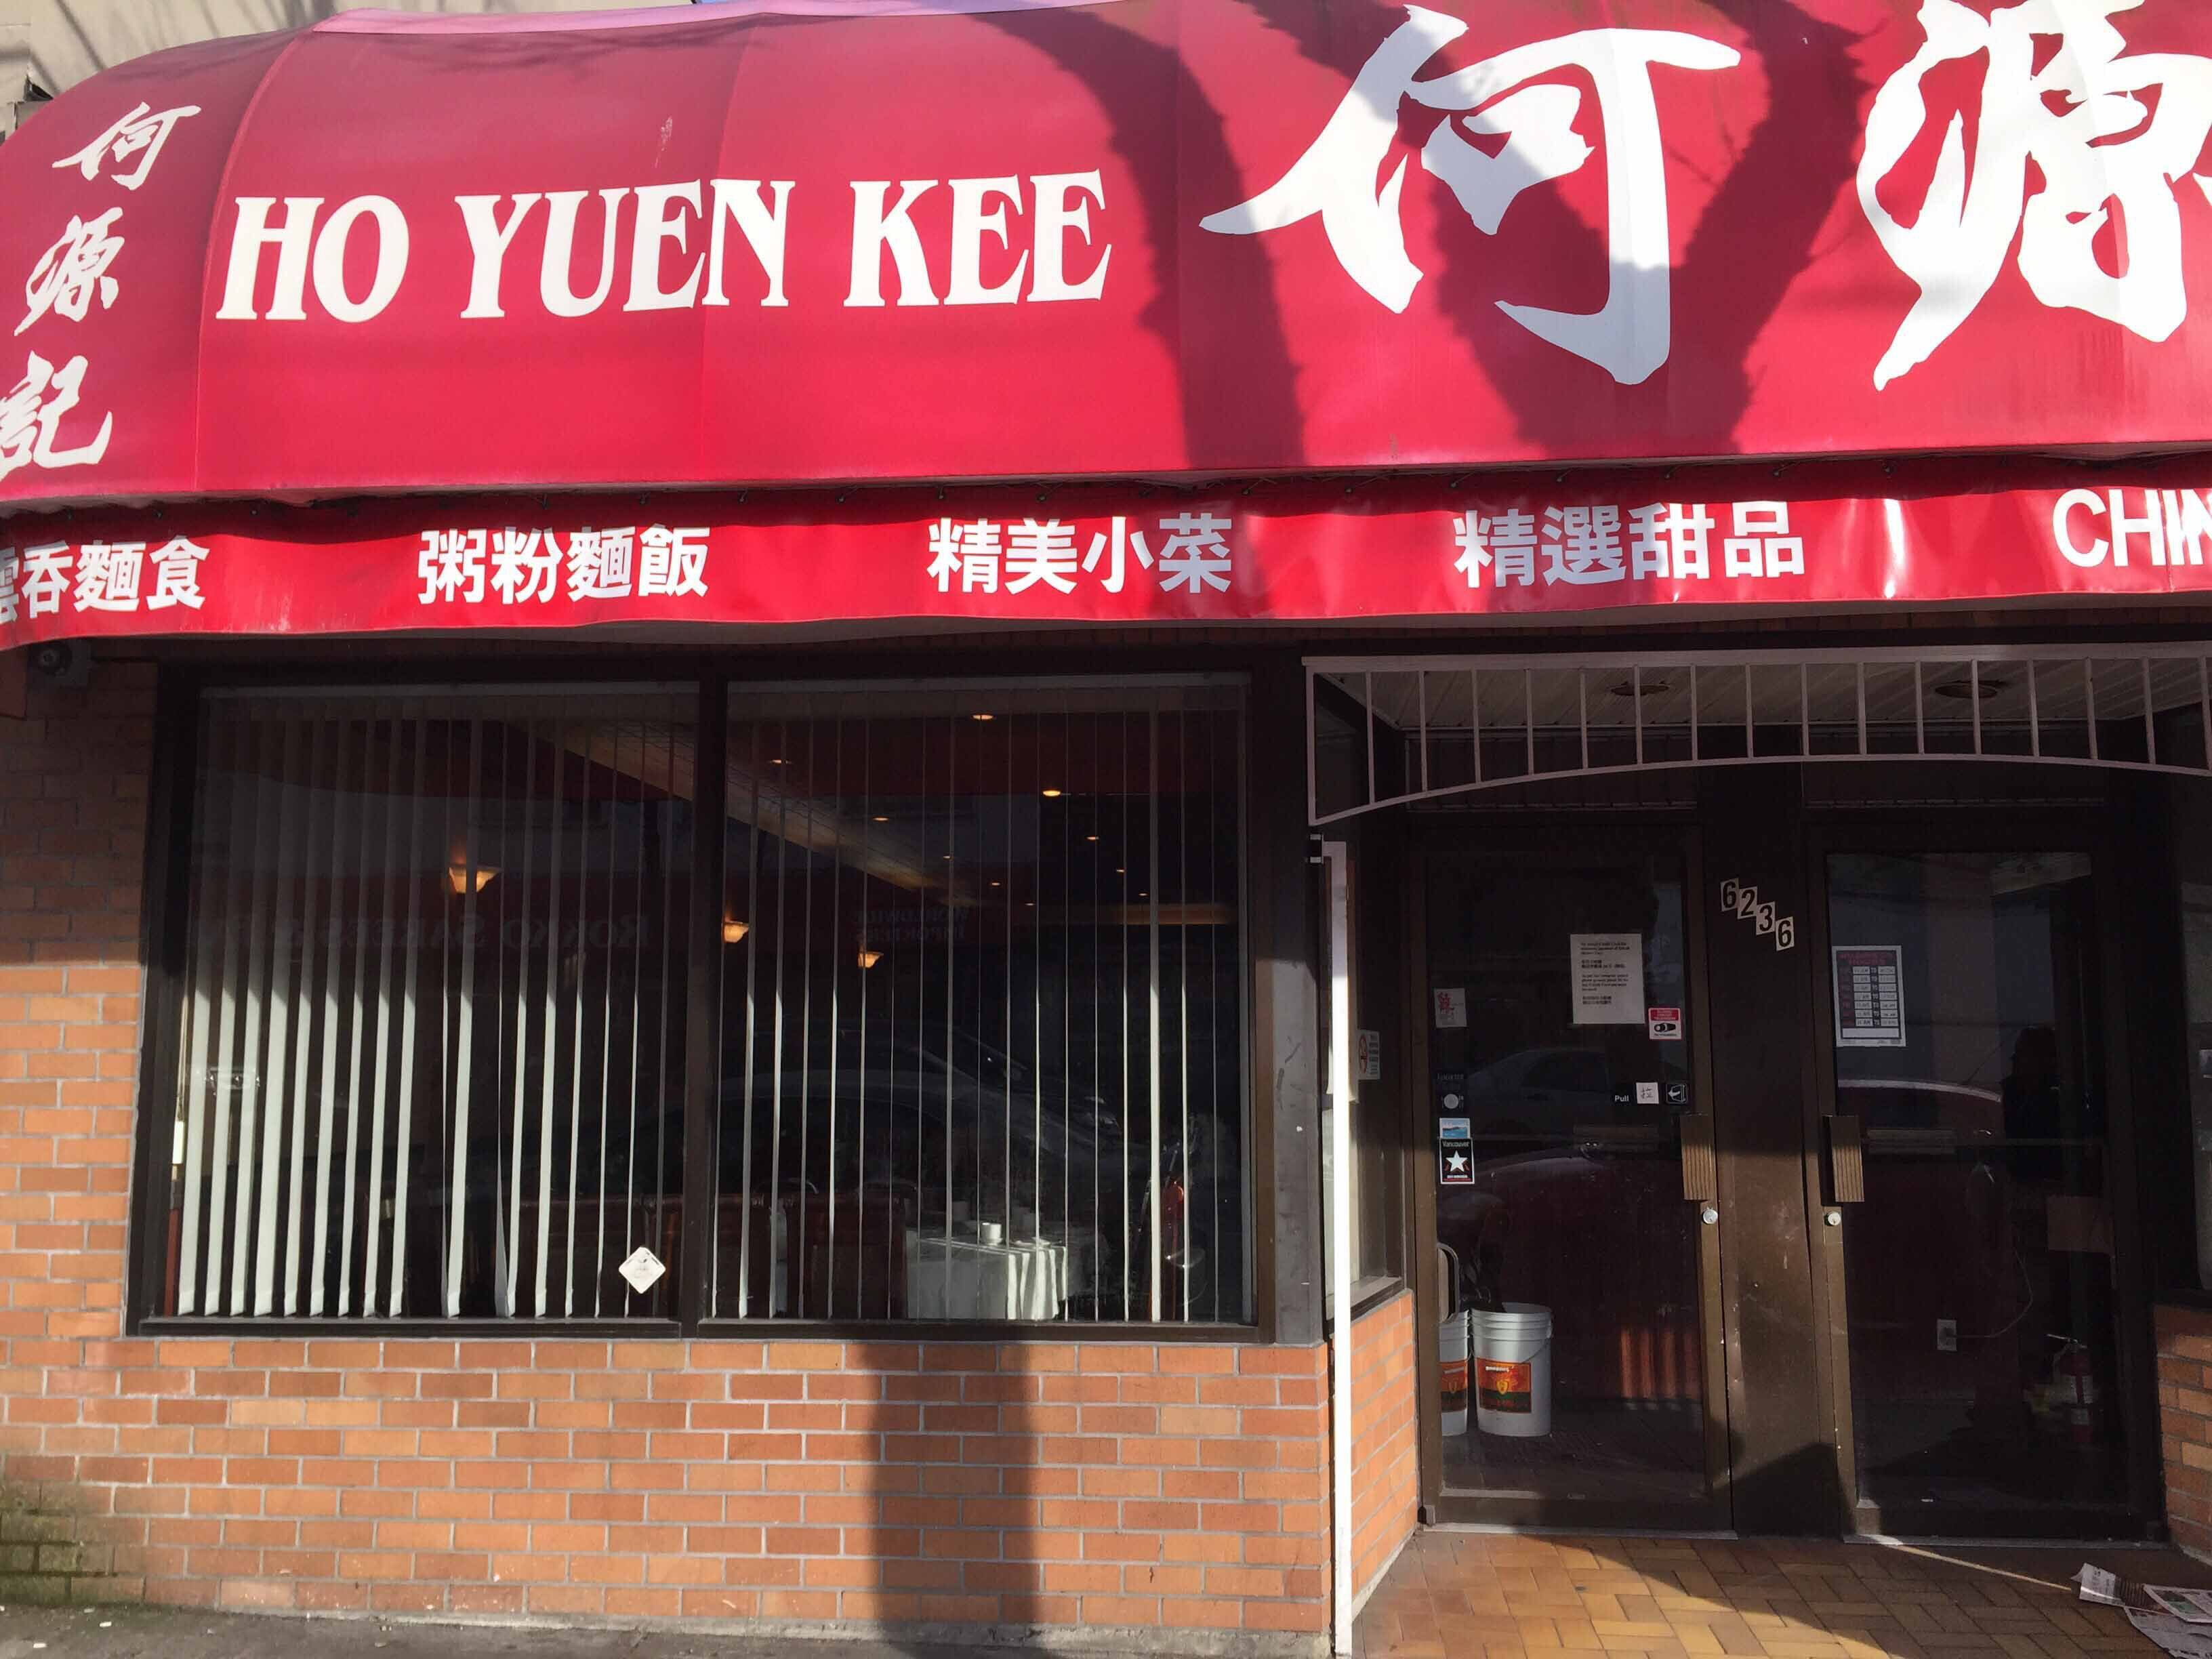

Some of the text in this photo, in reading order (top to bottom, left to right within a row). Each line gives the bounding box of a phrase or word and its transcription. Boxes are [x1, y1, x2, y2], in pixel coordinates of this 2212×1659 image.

[216, 169, 1112, 323] HO YUEN KEE
[418, 525, 710, 605] 粥粉麵飯
[927, 513, 1232, 595] 精美小菜
[1453, 501, 1805, 588] 精選甜品
[1723, 881, 1792, 947] 6236
